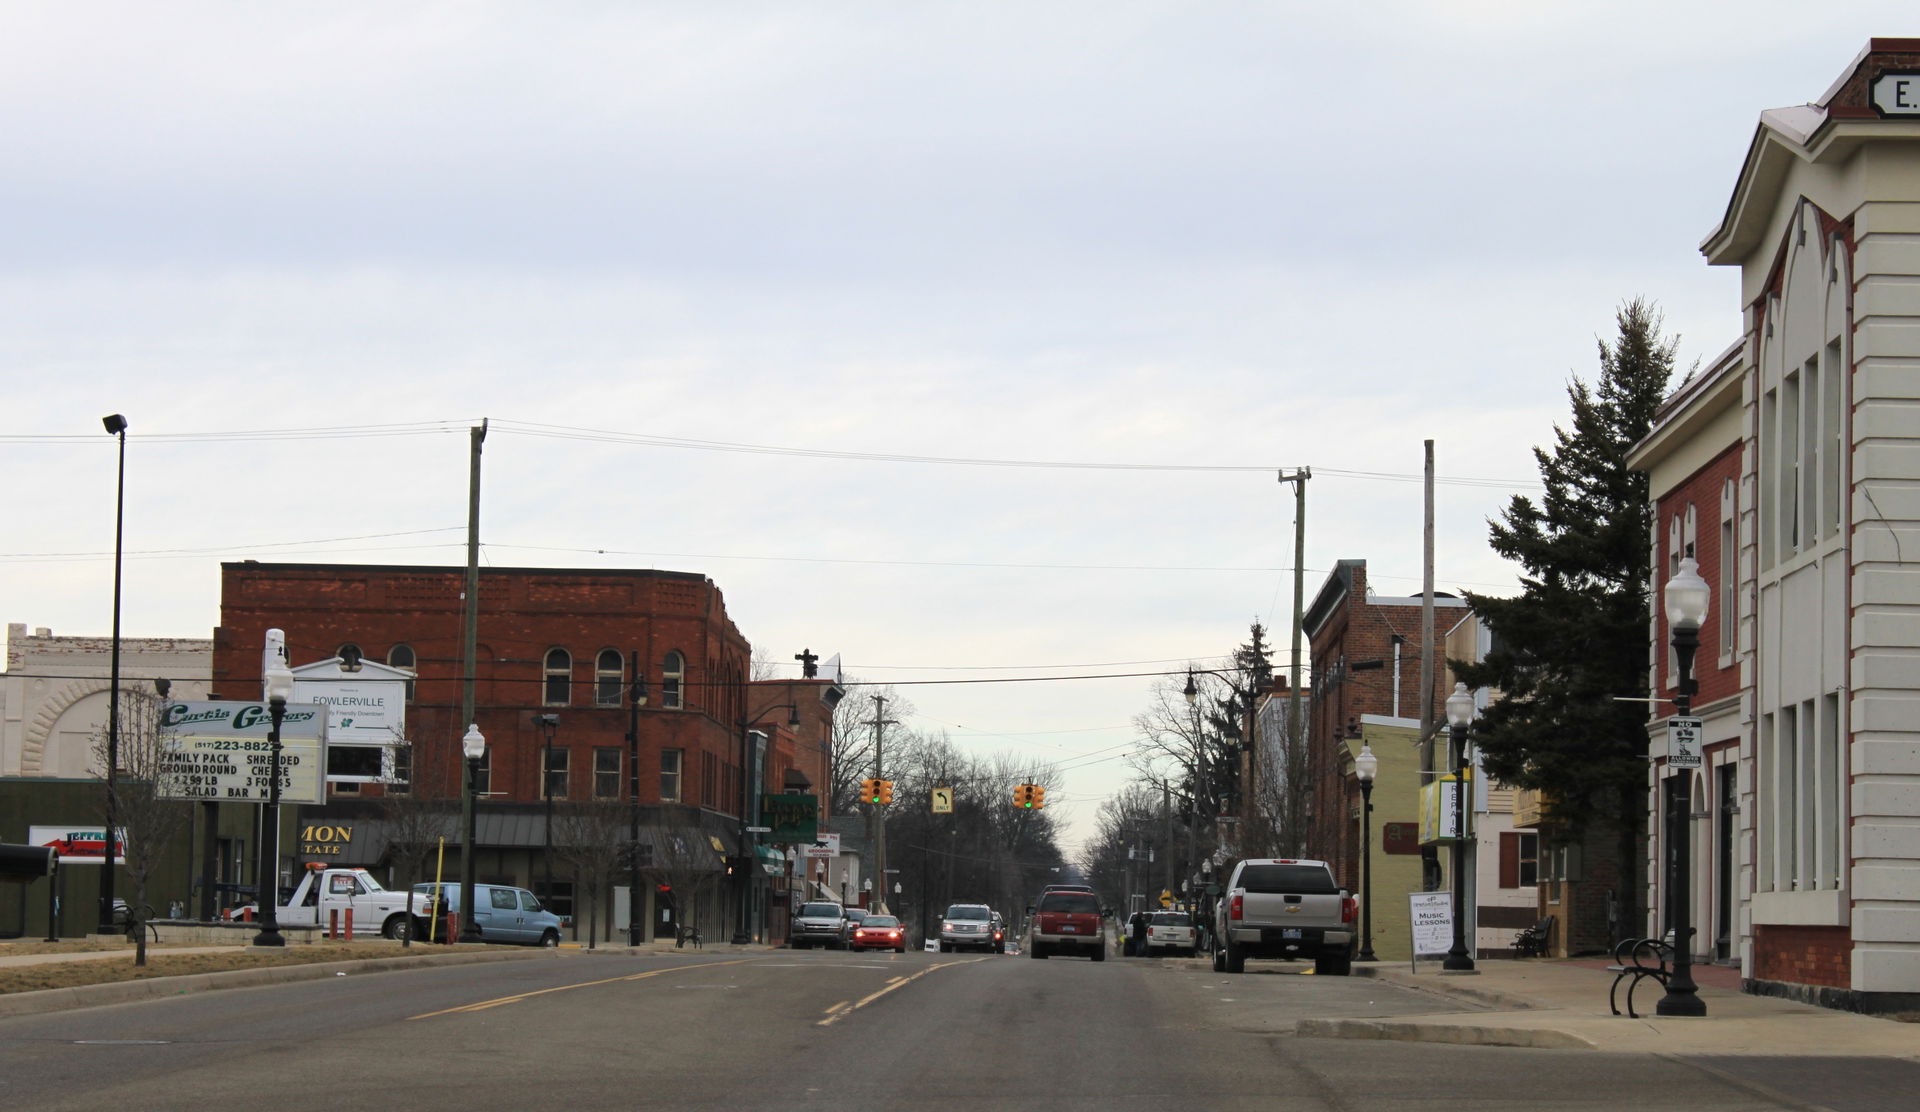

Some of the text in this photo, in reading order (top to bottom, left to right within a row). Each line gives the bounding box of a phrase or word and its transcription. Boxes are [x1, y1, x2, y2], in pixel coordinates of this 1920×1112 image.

[1896, 81, 1917, 108] E.
[313, 696, 384, 707] FOWLERVILLE
[162, 704, 316, 729] Curtis Groery
[161, 753, 300, 765] FAMILY PACK SHREDED
[252, 766, 289, 777] CHESE
[246, 777, 252, 786] 3
[185, 786, 283, 799] SALAD BAR MF
